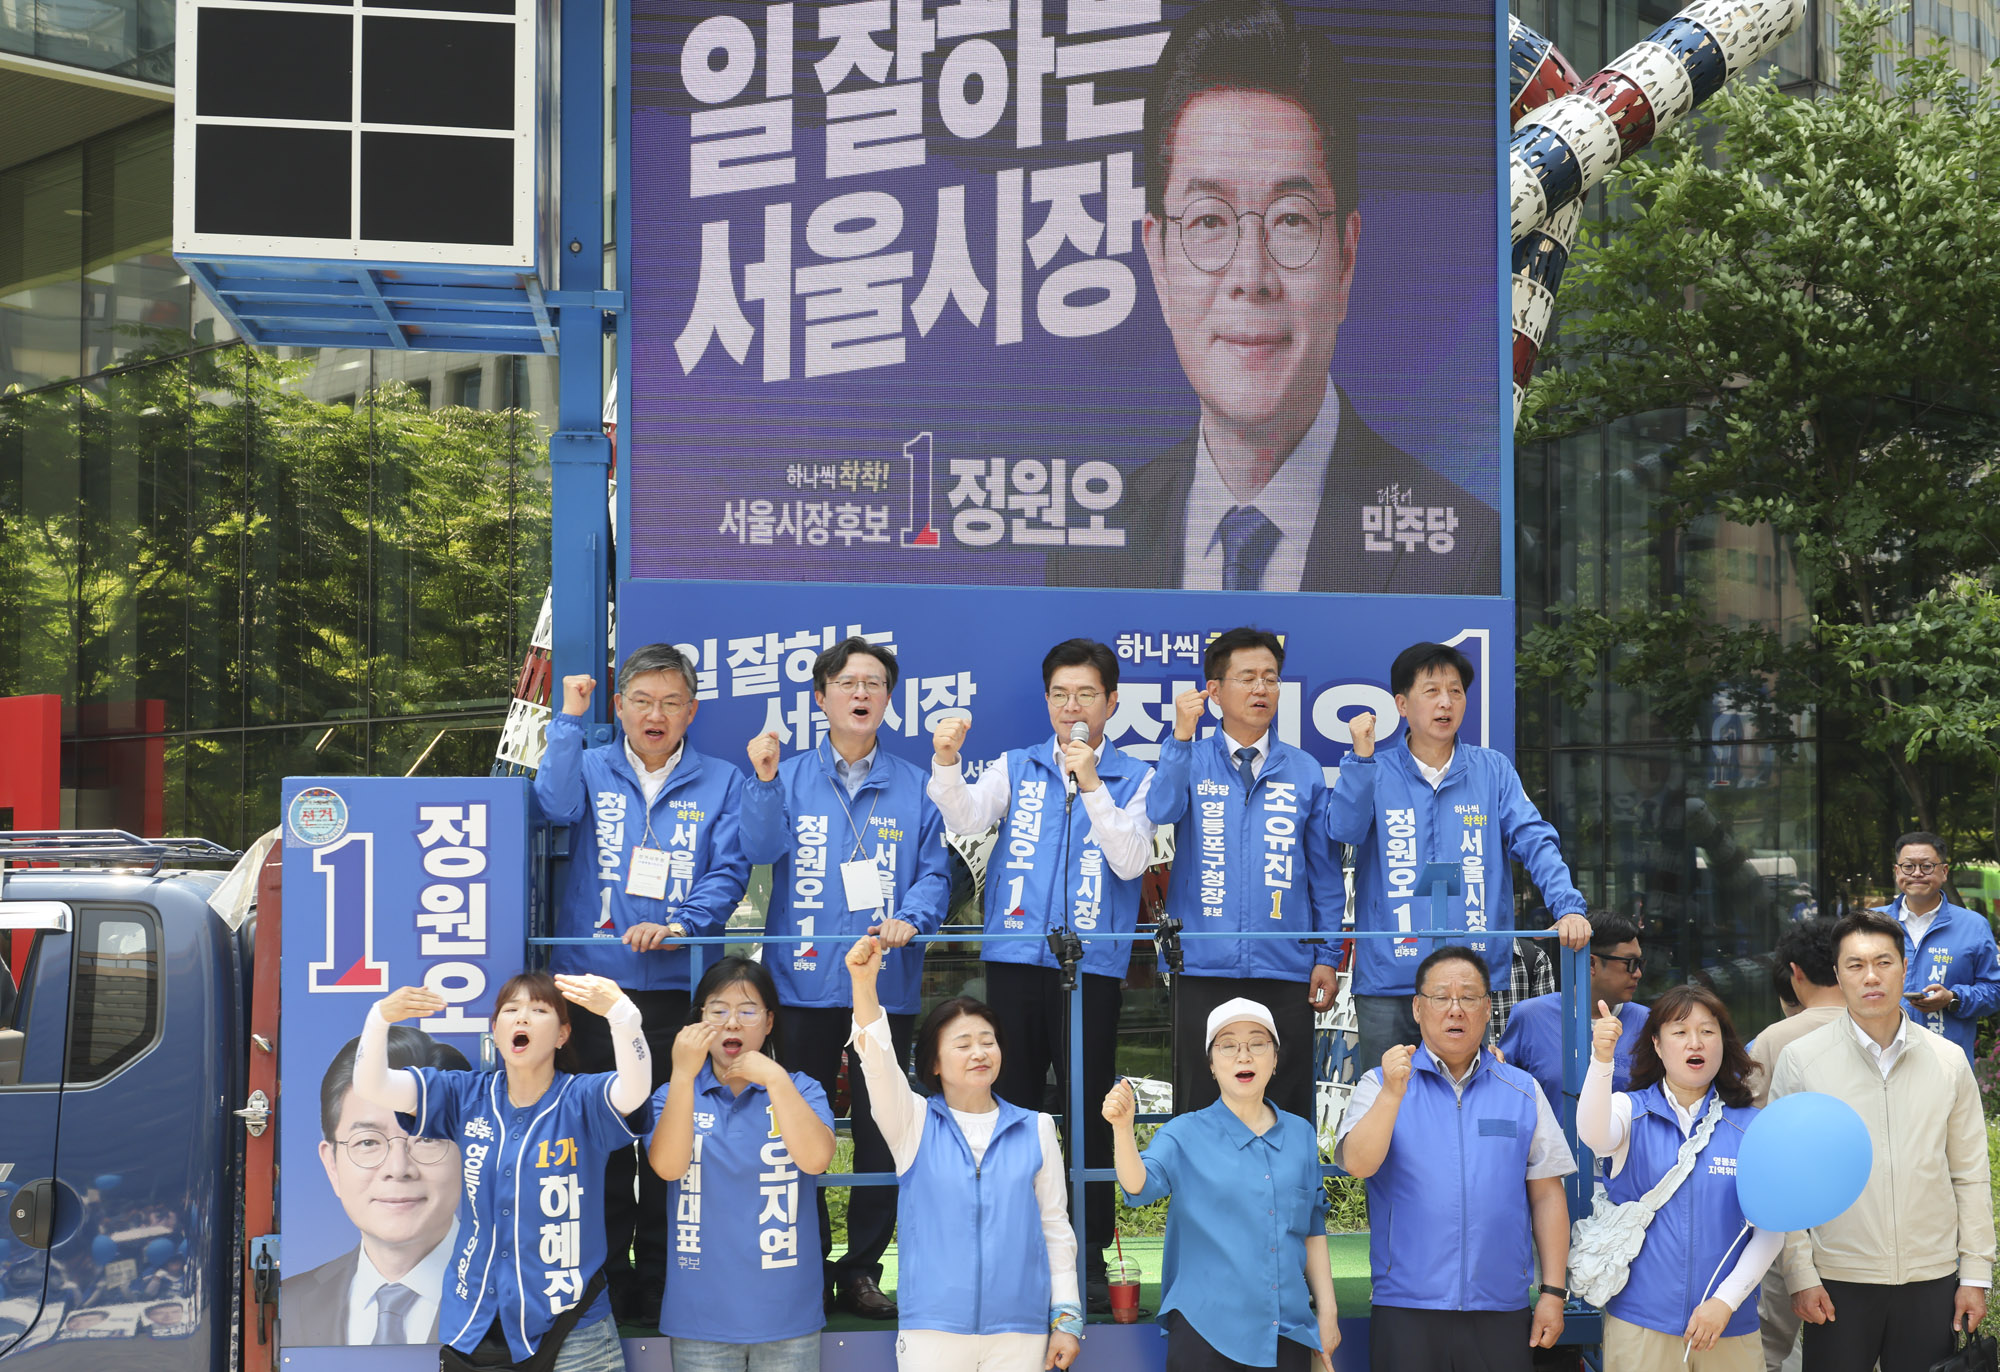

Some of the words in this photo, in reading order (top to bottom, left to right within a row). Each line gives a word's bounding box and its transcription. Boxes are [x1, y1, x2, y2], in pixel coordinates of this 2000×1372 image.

[681, 2, 796, 198] 일
[814, 0, 1171, 179] 잘하는
[673, 151, 1147, 383] 서울시장
[786, 463, 836, 489] 하나씩
[840, 460, 889, 492] 착착!
[901, 432, 940, 547] 1
[948, 458, 1126, 546] 정원오
[1363, 505, 1459, 553] 민주당
[1116, 633, 1199, 664] 하나씩
[669, 801, 697, 809] 하나씩
[1197, 784, 1229, 796] 민주당
[1454, 804, 1480, 814] 하나씩
[677, 810, 704, 822] 착착!
[870, 816, 896, 828] 하나씩
[878, 828, 903, 842] 착착!
[1006, 780, 1047, 870] 정원오
[1264, 781, 1297, 889] 조유진
[1463, 815, 1487, 826] 착착!
[596, 792, 626, 881] 정원오
[1201, 801, 1226, 905] 영등포구청장
[1385, 808, 1416, 898] 정원오
[793, 815, 828, 909] 정원오
[309, 832, 389, 993] 1
[594, 887, 615, 930] 1
[1004, 876, 1025, 916] 1
[1203, 907, 1223, 917] 후보
[1270, 890, 1283, 920] 1
[417, 804, 489, 1033] 정원오
[794, 916, 818, 957] 1
[1004, 919, 1024, 929] 민주당
[793, 962, 816, 971] 민주당
[1394, 947, 1418, 957] 민주당
[1471, 943, 1486, 952] 후보
[464, 1120, 494, 1141] 민주
[759, 1140, 798, 1270] 오지연
[540, 1173, 584, 1315] 하혜진
[678, 1255, 700, 1271] 후보
